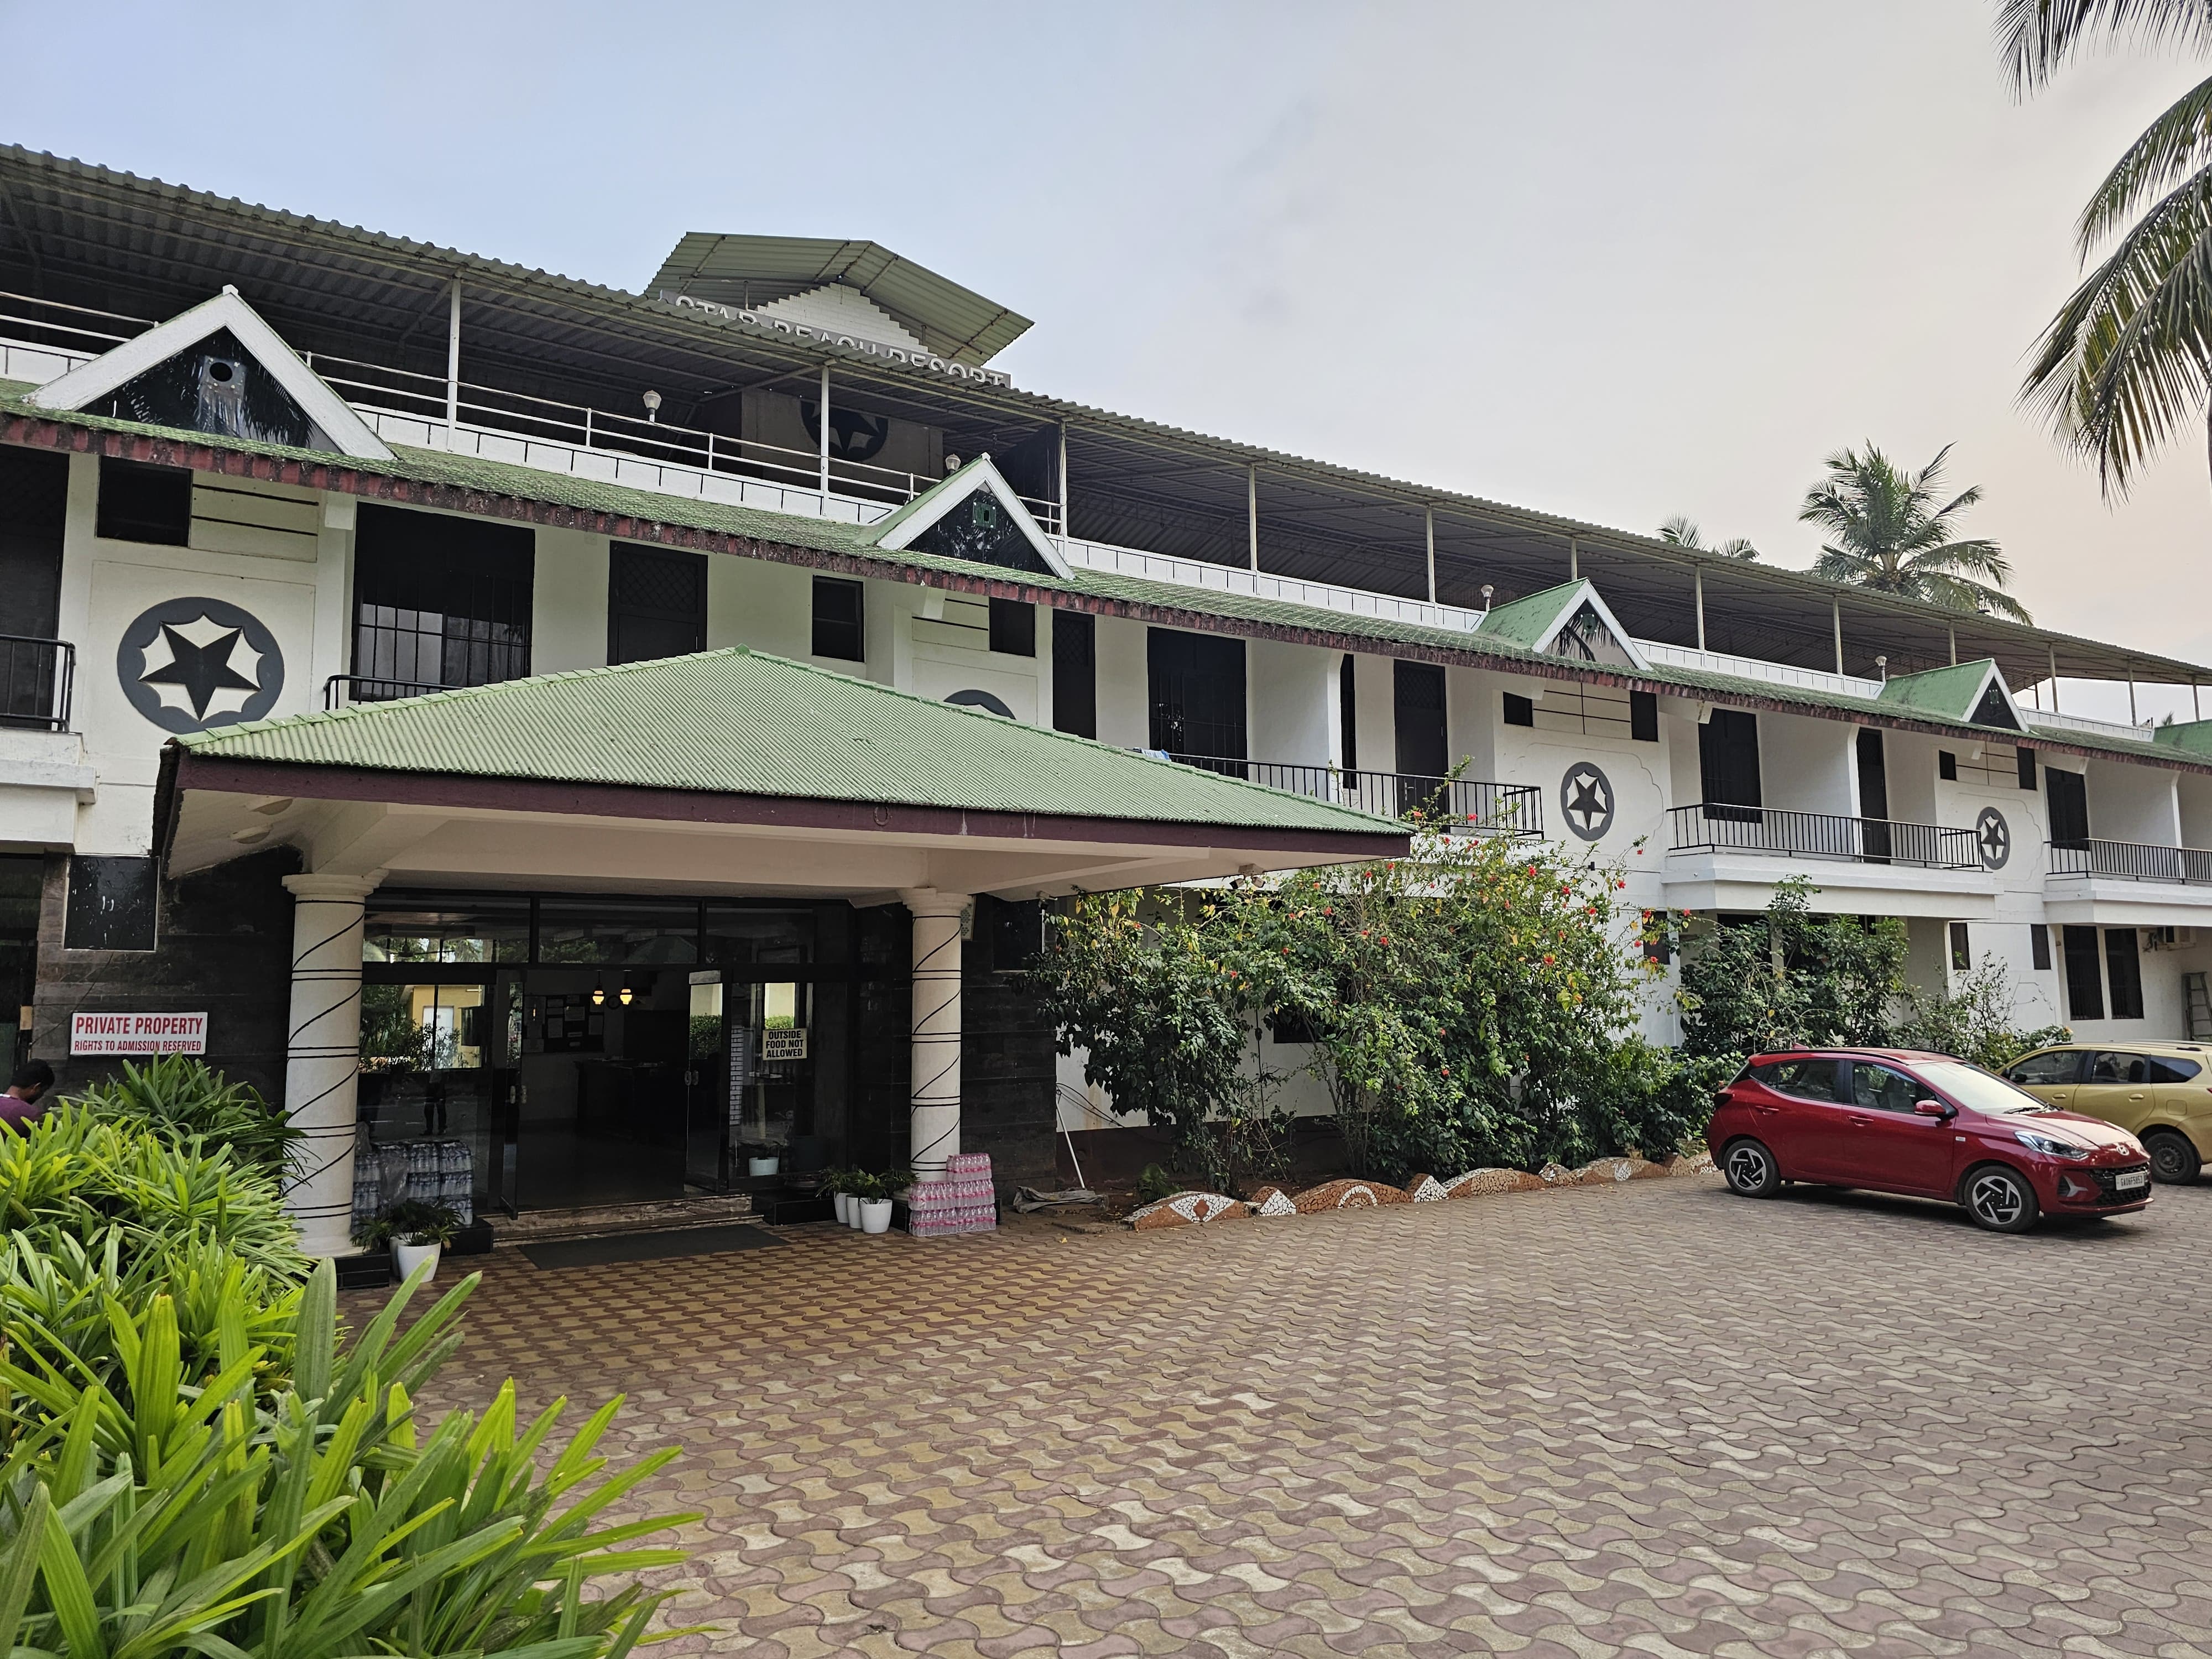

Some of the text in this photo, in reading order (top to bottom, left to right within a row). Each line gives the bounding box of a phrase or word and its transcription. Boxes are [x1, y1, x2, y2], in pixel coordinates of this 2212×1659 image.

[76, 1017, 203, 1034] PRIVATE PROPERTY
[769, 1030, 801, 1040] OUTSIDE
[75, 1040, 201, 1051] RIGHTS TO ADMISSION RESERVED
[766, 1040, 804, 1049] FOOD NOT
[766, 1048, 802, 1058] ALLOWED
